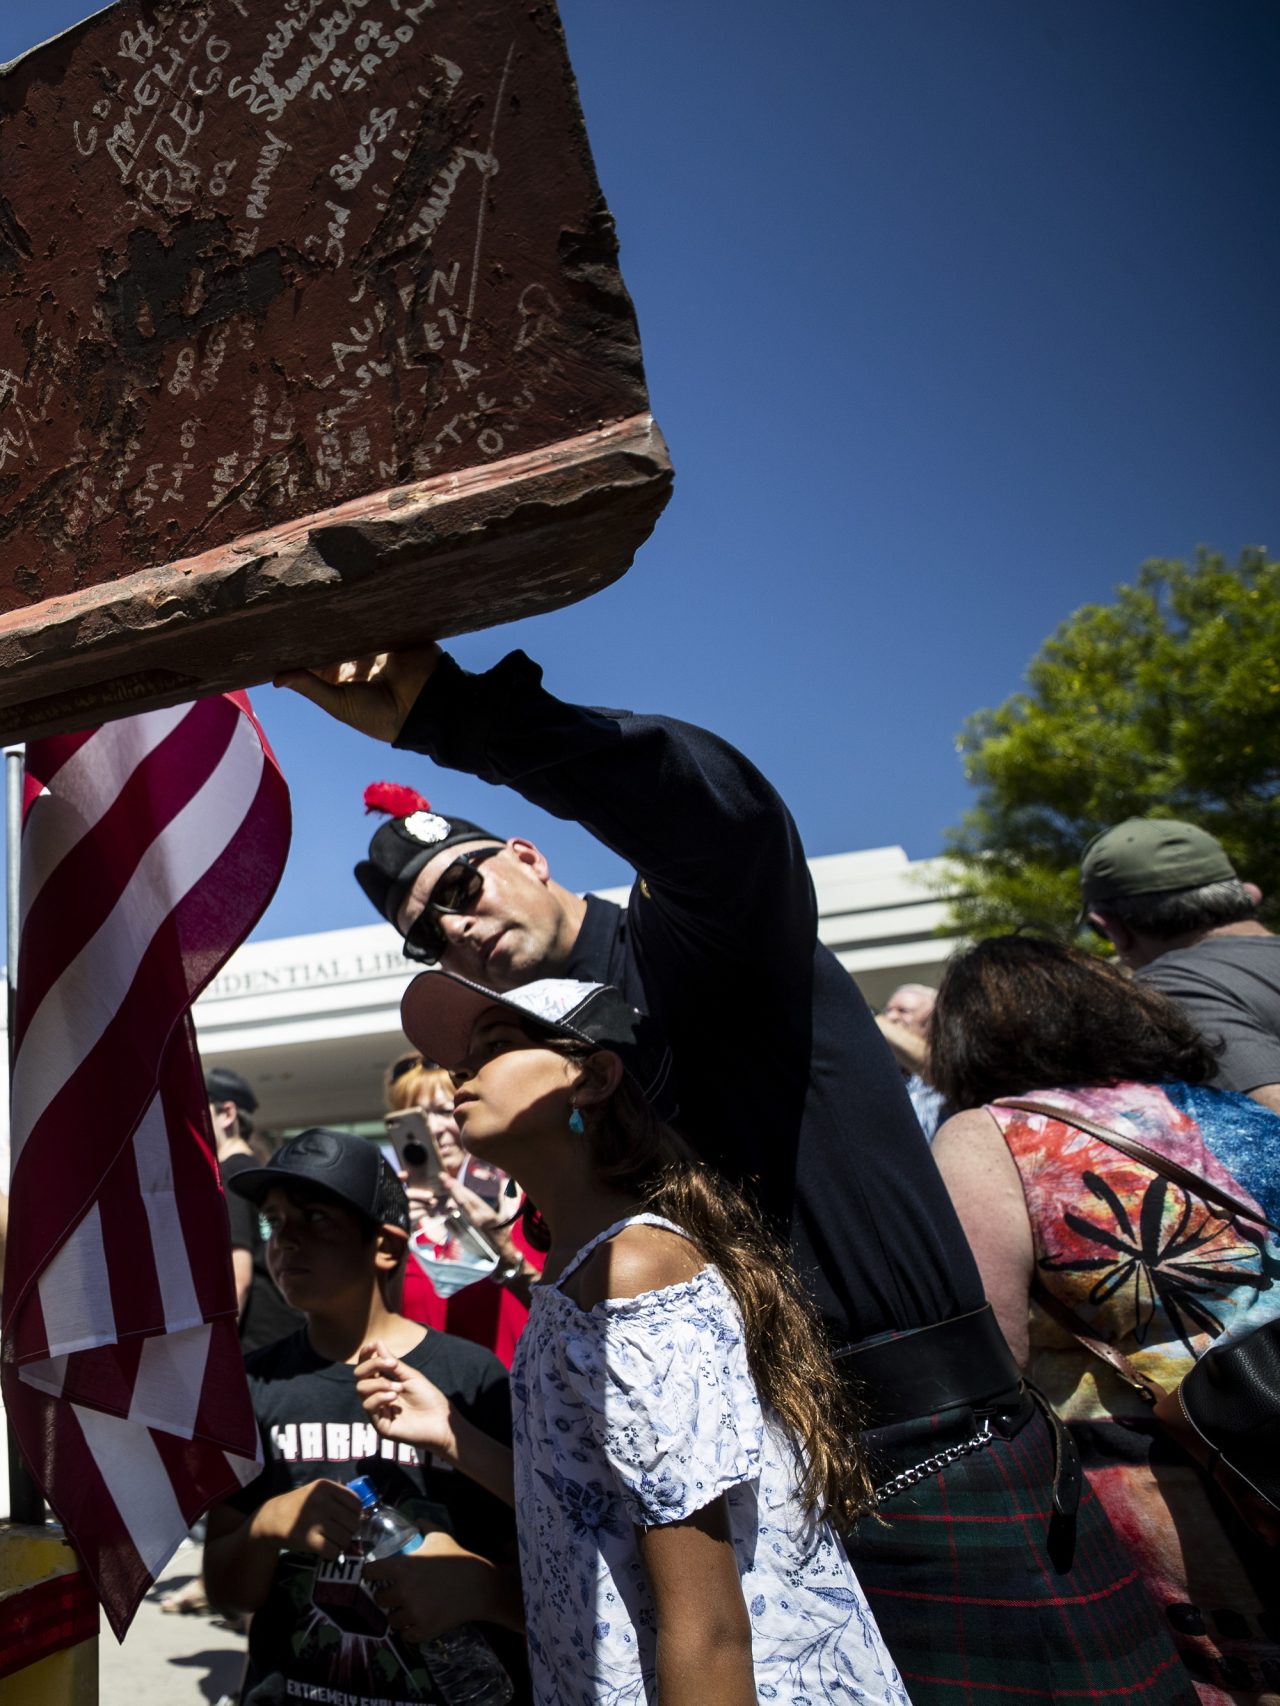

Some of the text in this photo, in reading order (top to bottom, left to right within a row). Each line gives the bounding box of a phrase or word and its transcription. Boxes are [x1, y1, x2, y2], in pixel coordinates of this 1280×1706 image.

[209, 948, 410, 995] IDENTIAL LIB
[270, 1422, 454, 1469] WARNI
[320, 1558, 359, 1581] TNT
